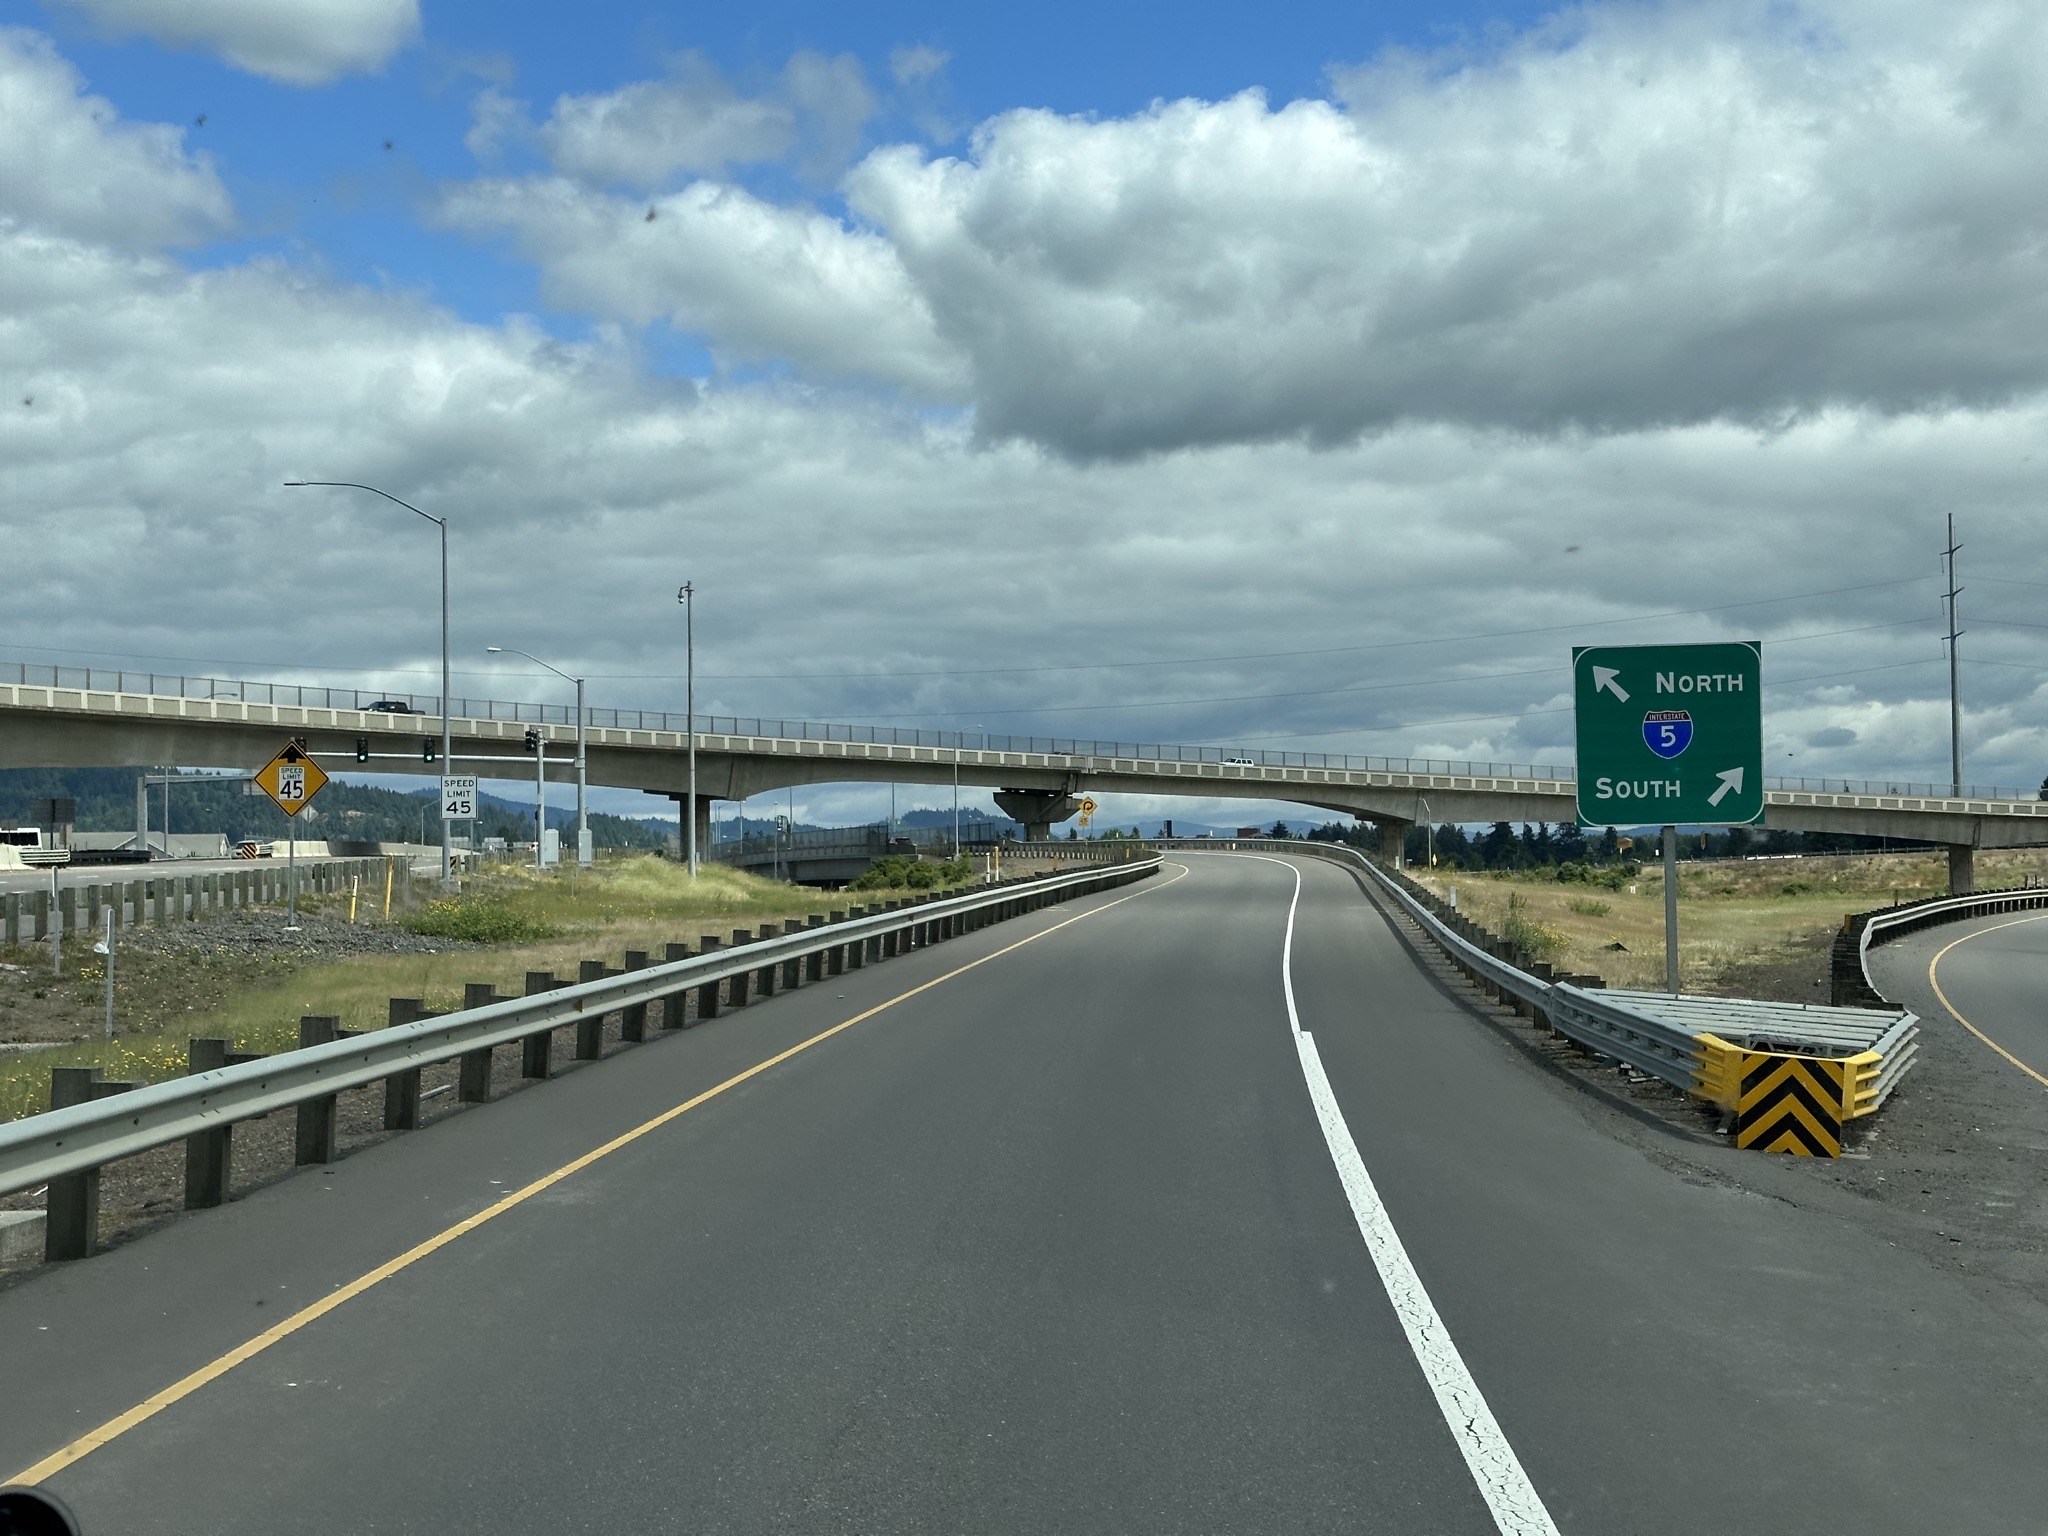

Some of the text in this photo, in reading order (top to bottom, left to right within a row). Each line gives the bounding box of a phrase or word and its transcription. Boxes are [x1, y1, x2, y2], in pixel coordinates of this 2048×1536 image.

[1656, 671, 1743, 694] NORTH
[1649, 712, 1686, 721] INTERSTATE
[1661, 725, 1676, 748] 5
[280, 780, 303, 799] 45
[444, 779, 475, 787] SPEED
[1595, 777, 1681, 799] SOUTH
[446, 801, 471, 814] 45
